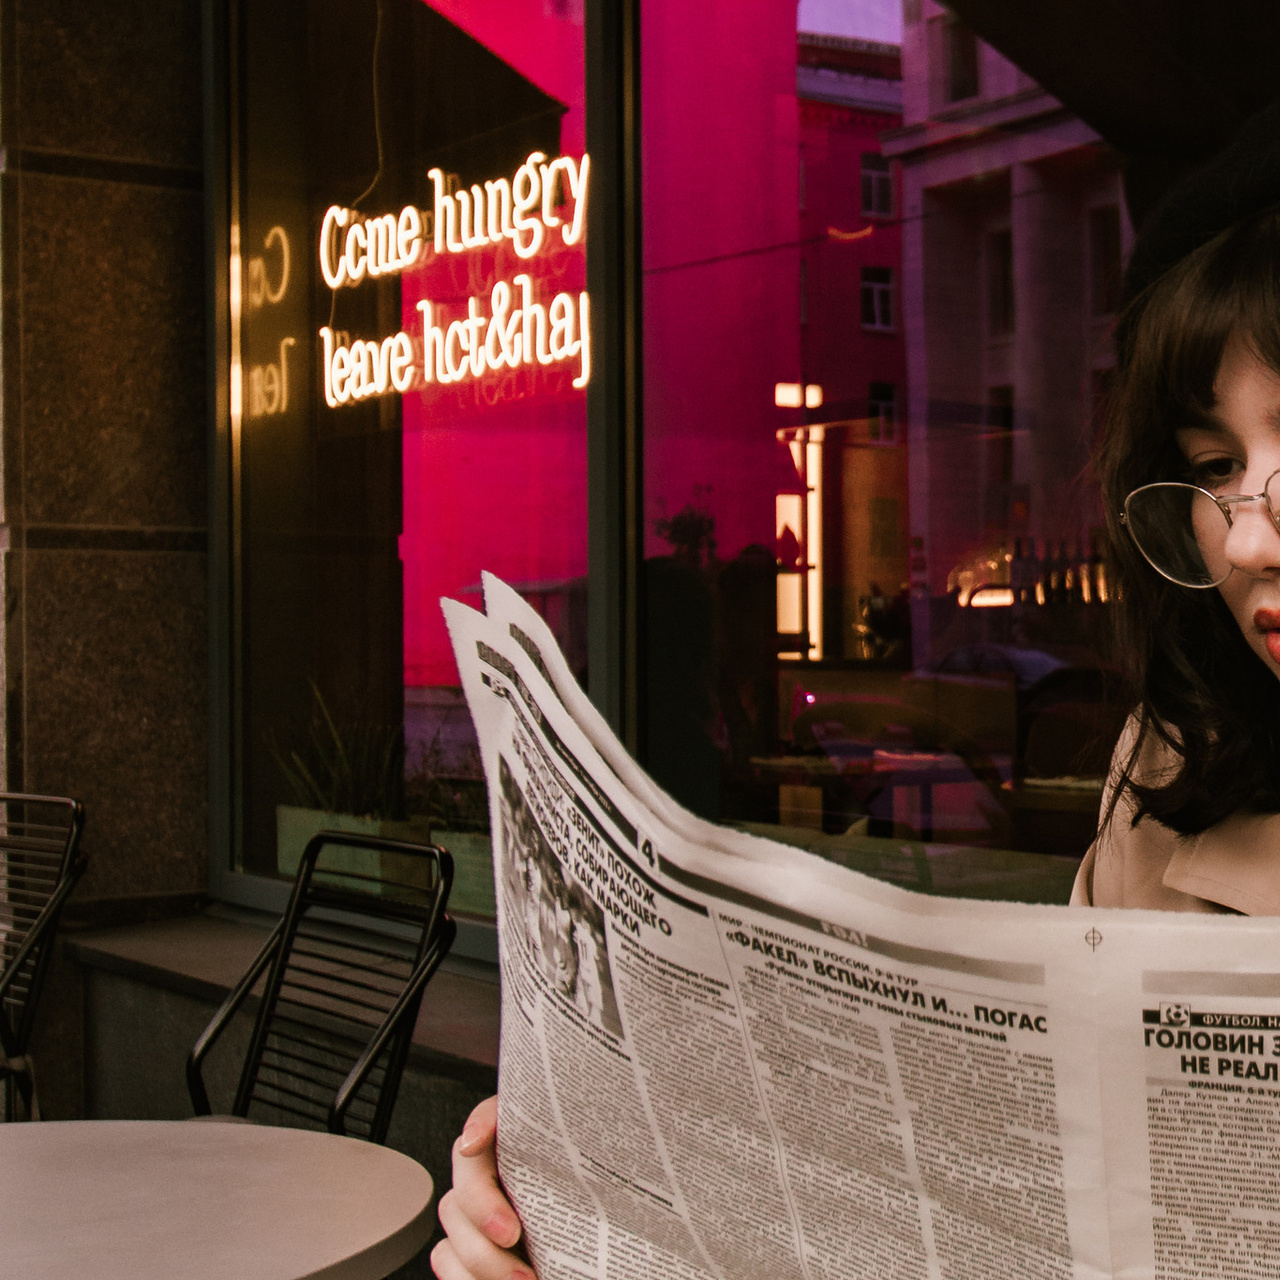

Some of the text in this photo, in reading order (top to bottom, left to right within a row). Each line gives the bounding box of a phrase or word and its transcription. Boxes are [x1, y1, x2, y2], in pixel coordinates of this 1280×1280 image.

[320, 151, 590, 289] Come hungry
[319, 326, 413, 408] leave
[608, 850, 657, 910] ПОХОЖ
[642, 838, 656, 868] 4
[574, 858, 640, 938] КАК МАРКИ
[576, 837, 672, 937] СОБИРАЮЩЕГО
[751, 923, 821, 956] ЧЕМПИОНАТ
[726, 930, 809, 969] «ФАКЕЛ»
[812, 958, 926, 1008] ВСПЫХНУЛ
[973, 1004, 1048, 1033] ПОГАС
[1143, 1028, 1265, 1057] ГОЛОВИН
[1202, 1013, 1265, 1029] ФУТБОЛ.
[1179, 1055, 1211, 1076] НЕ
